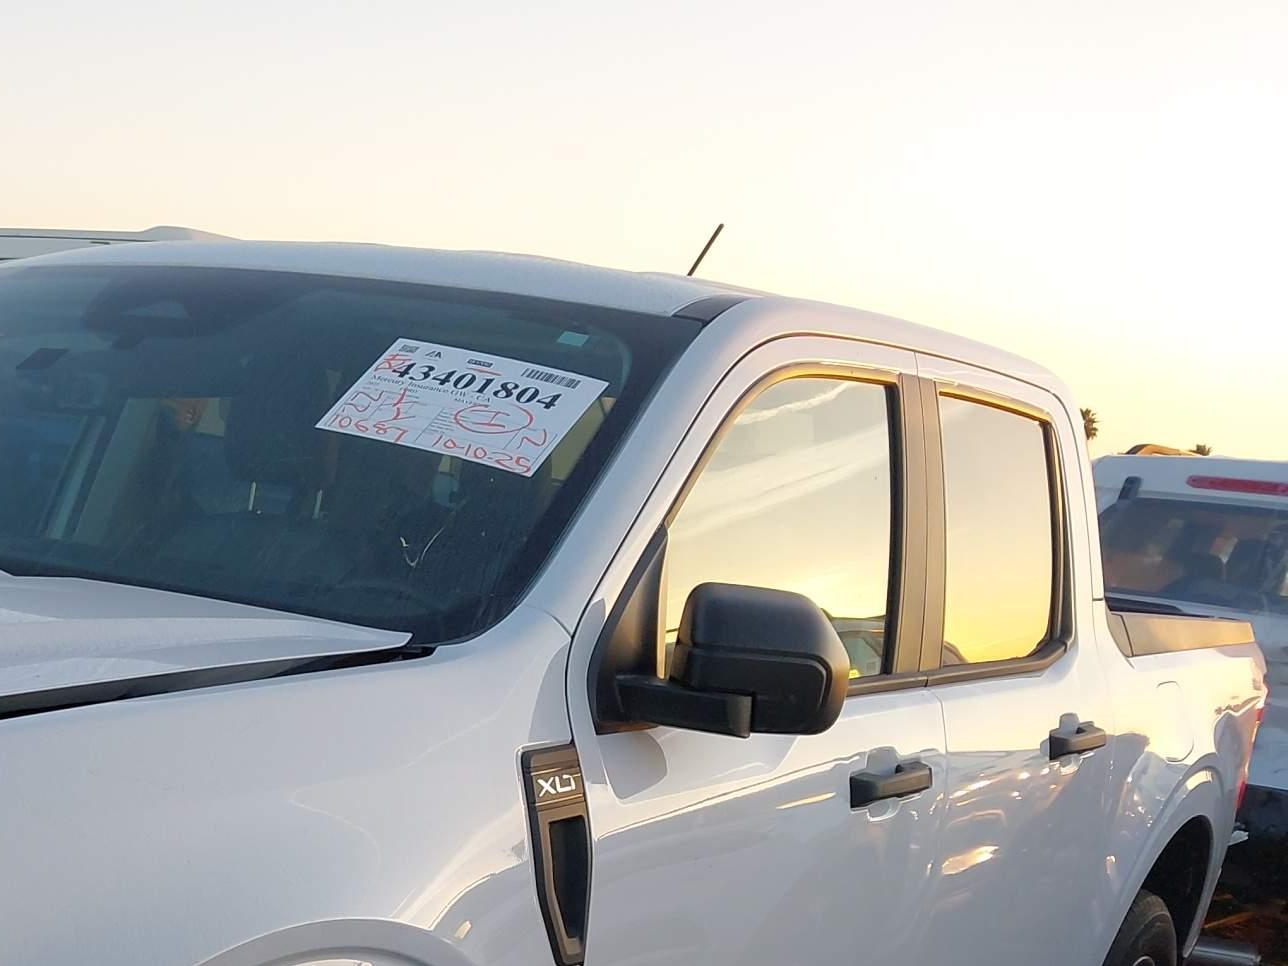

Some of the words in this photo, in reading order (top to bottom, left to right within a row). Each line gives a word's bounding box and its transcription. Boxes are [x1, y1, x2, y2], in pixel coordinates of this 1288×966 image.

[392, 361, 562, 410] 43401804
[431, 434, 531, 474] 10-10-25
[537, 773, 581, 798] XLT
